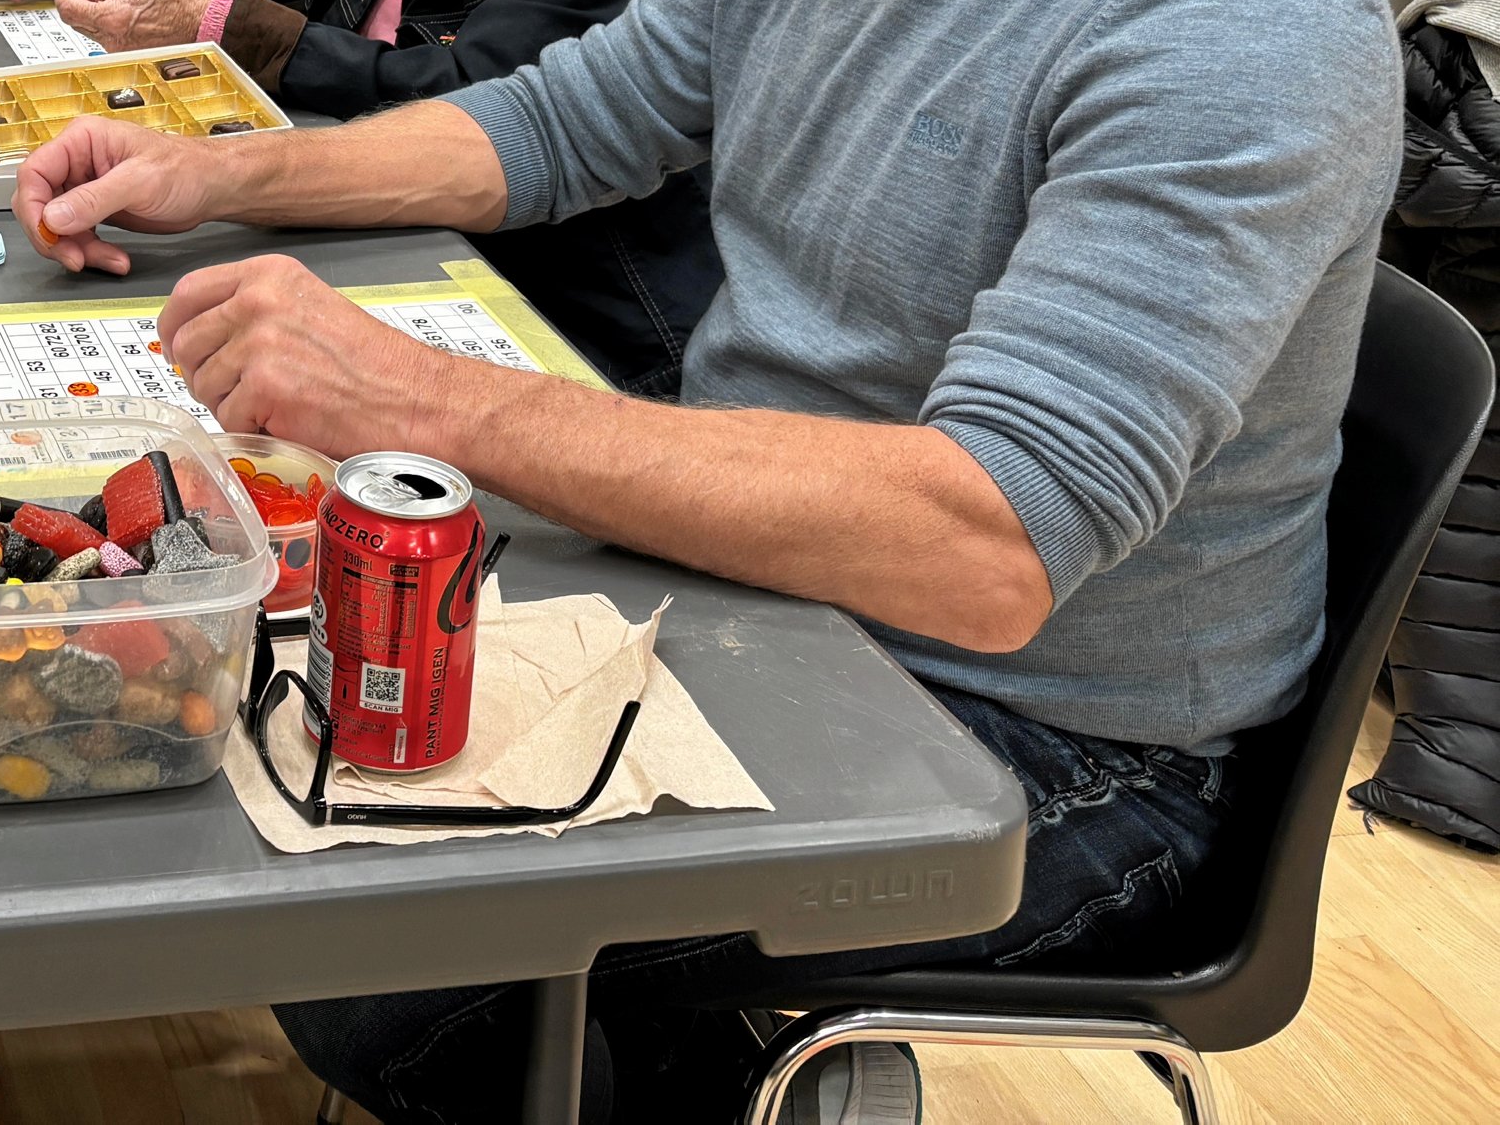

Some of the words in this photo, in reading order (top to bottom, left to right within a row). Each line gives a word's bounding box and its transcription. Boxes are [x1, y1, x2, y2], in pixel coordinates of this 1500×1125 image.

[457, 303, 478, 315] 90
[39, 323, 57, 335] 82
[68, 322, 86, 333] 81
[137, 319, 155, 330] 80
[45, 335, 63, 346] 72
[74, 333, 93, 345] 70
[490, 338, 512, 350] 56
[51, 346, 70, 358] 60
[82, 345, 100, 357] 63
[125, 344, 142, 355] 64
[461, 340, 482, 352] 50
[27, 361, 45, 373] 53
[94, 370, 113, 382] 45
[136, 369, 155, 380] 47
[41, 386, 59, 399] 31
[70, 382, 91, 395] 33
[144, 382, 164, 392] 30
[334, 519, 383, 549] ZERO
[343, 550, 373, 571] 330ml
[433, 646, 445, 682] IGEN
[429, 683, 442, 719] MIG
[363, 702, 383, 711] SCAN
[384, 706, 400, 714] MIG
[425, 721, 438, 758] PANT
